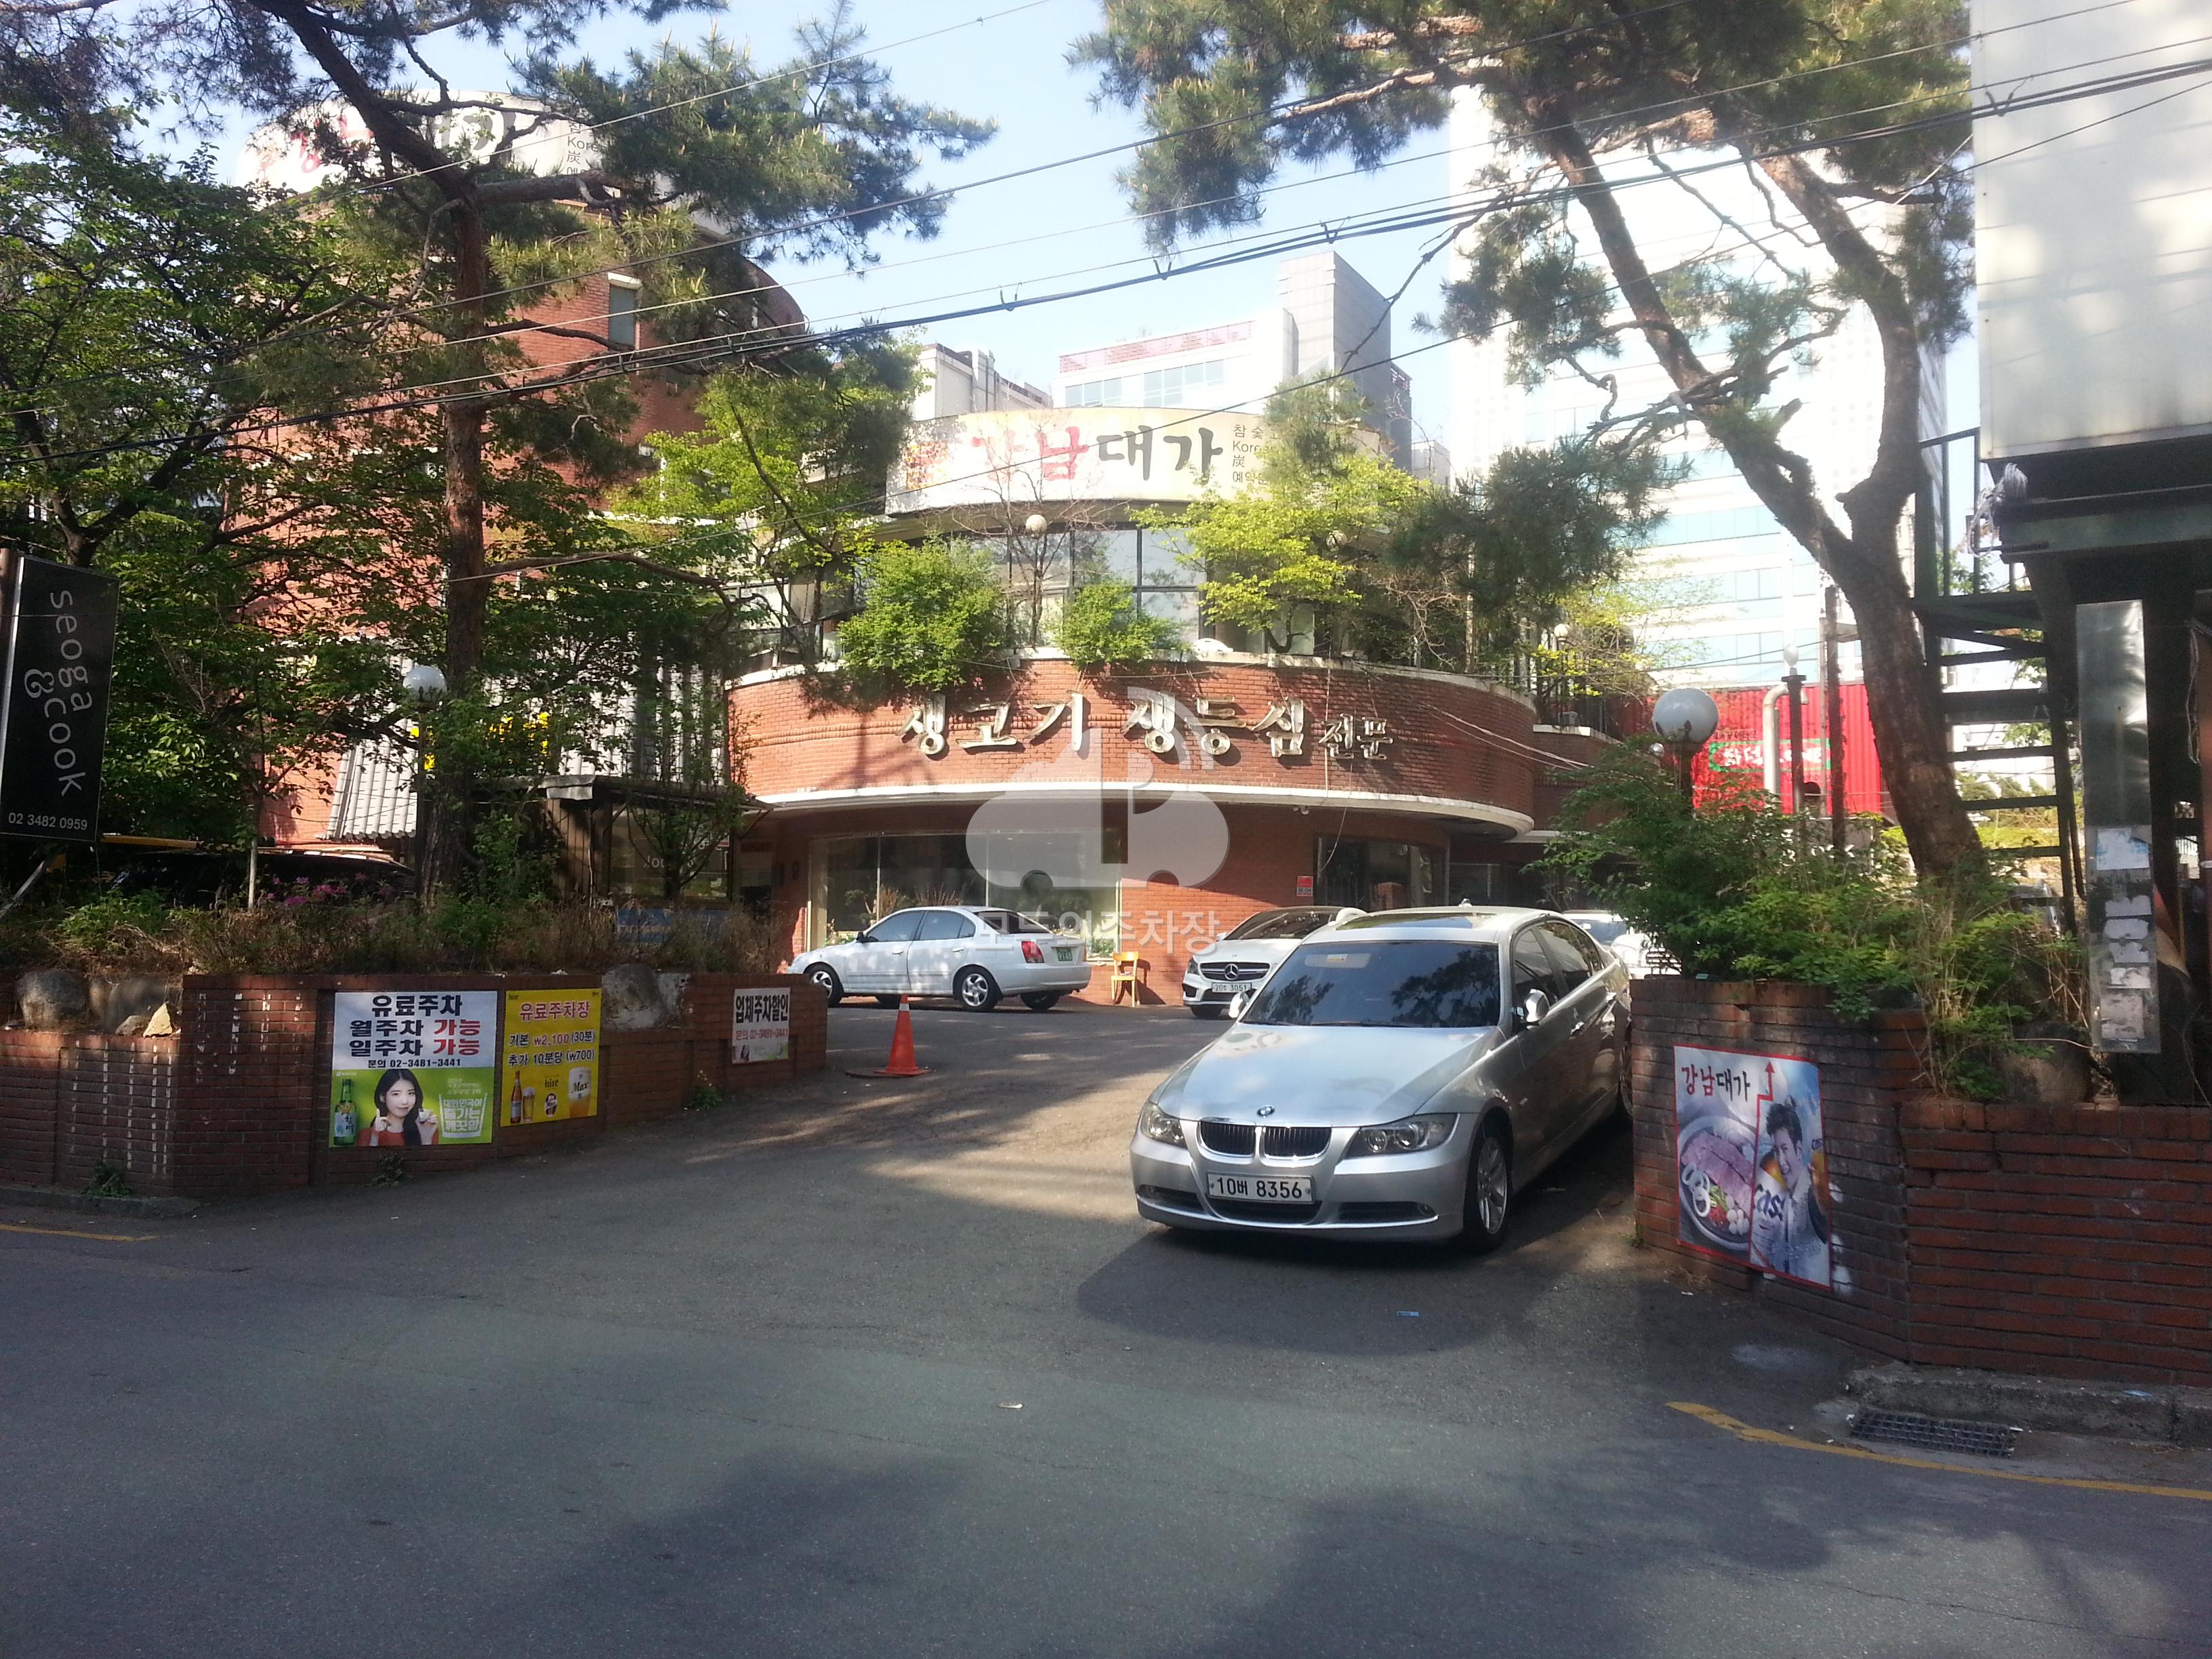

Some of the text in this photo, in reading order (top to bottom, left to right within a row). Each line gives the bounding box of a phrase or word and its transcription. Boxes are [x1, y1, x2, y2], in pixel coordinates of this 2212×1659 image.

[895, 689, 1393, 760] 생고기 생등심 전문
[44, 697, 86, 798] cook
[8, 813, 87, 831] 02 3482 0959
[371, 994, 463, 1017] 유료주차
[519, 1000, 590, 1022] 유료주차장
[735, 994, 789, 1024] 업체주차할인
[350, 1019, 481, 1038] 월주차 가능
[348, 1038, 480, 1057] 일주차 가능
[509, 1033, 529, 1047] 기본
[368, 1058, 461, 1069] 문의 02-3481-3441
[508, 1053, 529, 1067] 추가
[533, 1050, 563, 1065] 10분당
[1681, 1063, 1750, 1103] 강남대가
[1256, 1181, 1303, 1199] 8356
